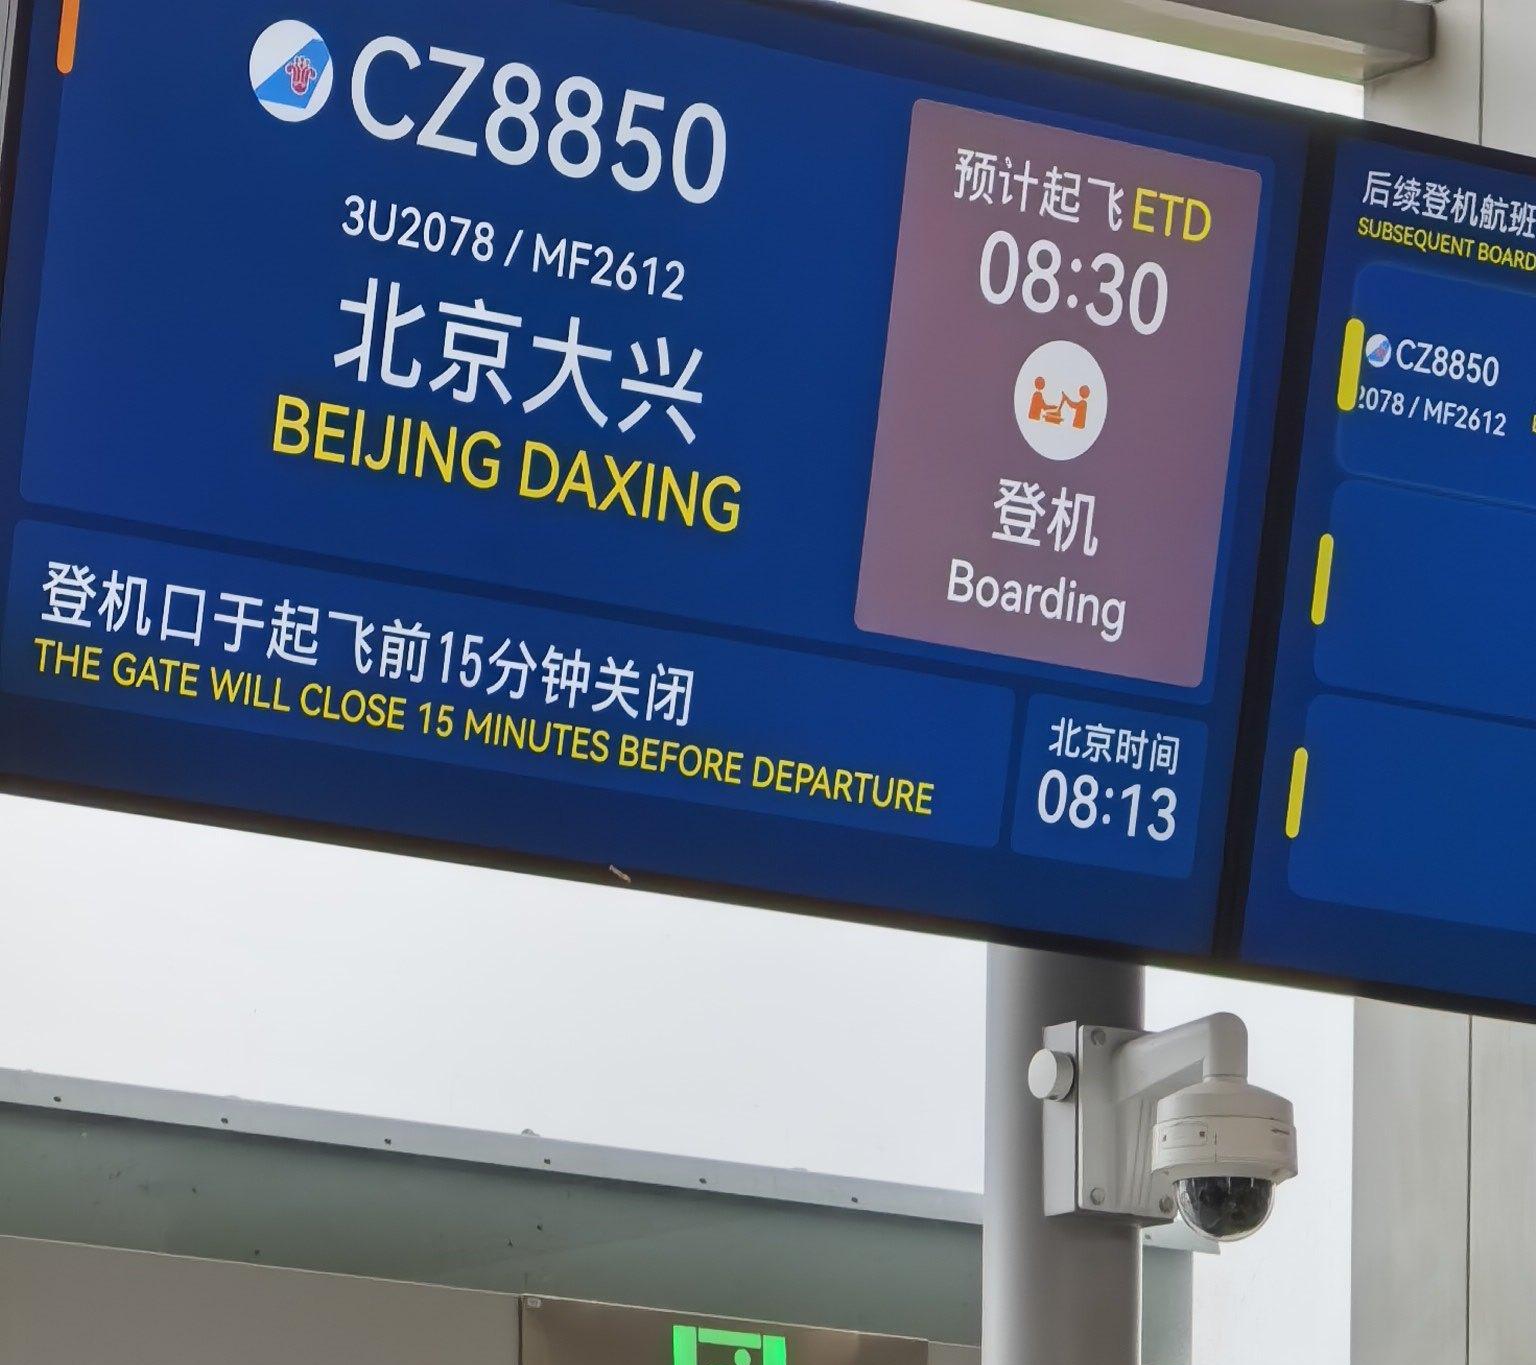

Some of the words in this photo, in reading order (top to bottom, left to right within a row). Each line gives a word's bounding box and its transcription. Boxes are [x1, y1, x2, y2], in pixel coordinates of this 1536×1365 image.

[352, 36, 727, 205] CZ8850
[954, 148, 1124, 232] 预计起飞
[1131, 188, 1212, 243] ETD
[1357, 217, 1474, 259] SUBSEQUENT
[342, 195, 495, 263] 3U2078
[532, 233, 686, 302] MF2612
[978, 230, 1169, 336] 08:30
[334, 277, 703, 445] 北京大兴
[1396, 339, 1500, 387] CZ8850
[272, 393, 501, 490] BEIJING
[518, 439, 742, 533] DAXING
[1423, 398, 1507, 437] MF2612
[991, 478, 1099, 557] 登机
[42, 561, 694, 728] 登机口于起飞前15分钟关闭
[946, 558, 1127, 643] Boarding
[34, 638, 101, 682] THE
[112, 652, 199, 697] GATE
[210, 667, 290, 712] WILL
[300, 683, 406, 730] CLOSE
[418, 702, 454, 738] 15
[463, 709, 610, 763] MINUTES
[618, 735, 743, 785] BEFORE
[751, 755, 935, 815] DEPARTURE
[1049, 717, 1180, 775] 北京时间
[1037, 768, 1177, 843] 08:13
